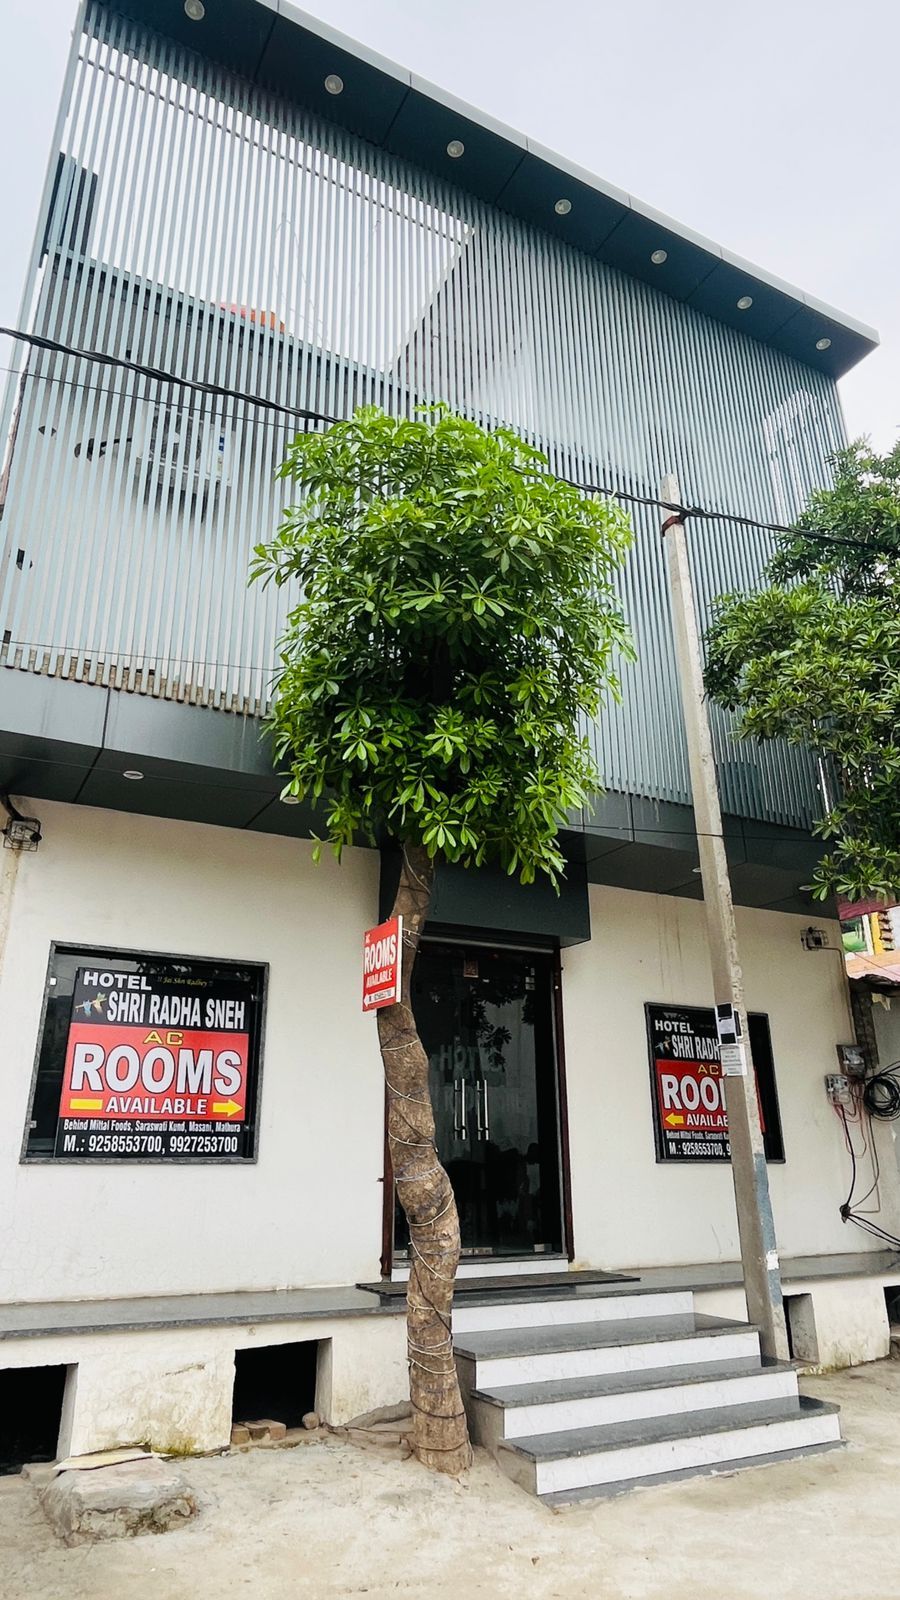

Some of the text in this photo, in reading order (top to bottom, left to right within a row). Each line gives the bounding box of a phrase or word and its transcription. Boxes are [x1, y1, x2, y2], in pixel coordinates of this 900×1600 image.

[364, 934, 397, 974] ROOMS
[83, 971, 152, 991] HOTEL
[366, 968, 393, 988] AVAILABLE
[107, 990, 245, 1030] SHRI RADHA SNEH
[655, 1020, 695, 1034] HOTEL
[143, 1030, 185, 1046] AC
[671, 1034, 721, 1060] SHRI RADH
[69, 1042, 243, 1097] ROOMS
[698, 1064, 719, 1075] AC
[661, 1074, 727, 1111] ROO
[105, 1096, 208, 1115] AVAILABLE
[63, 1118, 241, 1134] Behind Mittal Foods, Saraswati Kund, Masani, Mathura
[63, 1134, 238, 1155] M.: 9258553700, 9927253700
